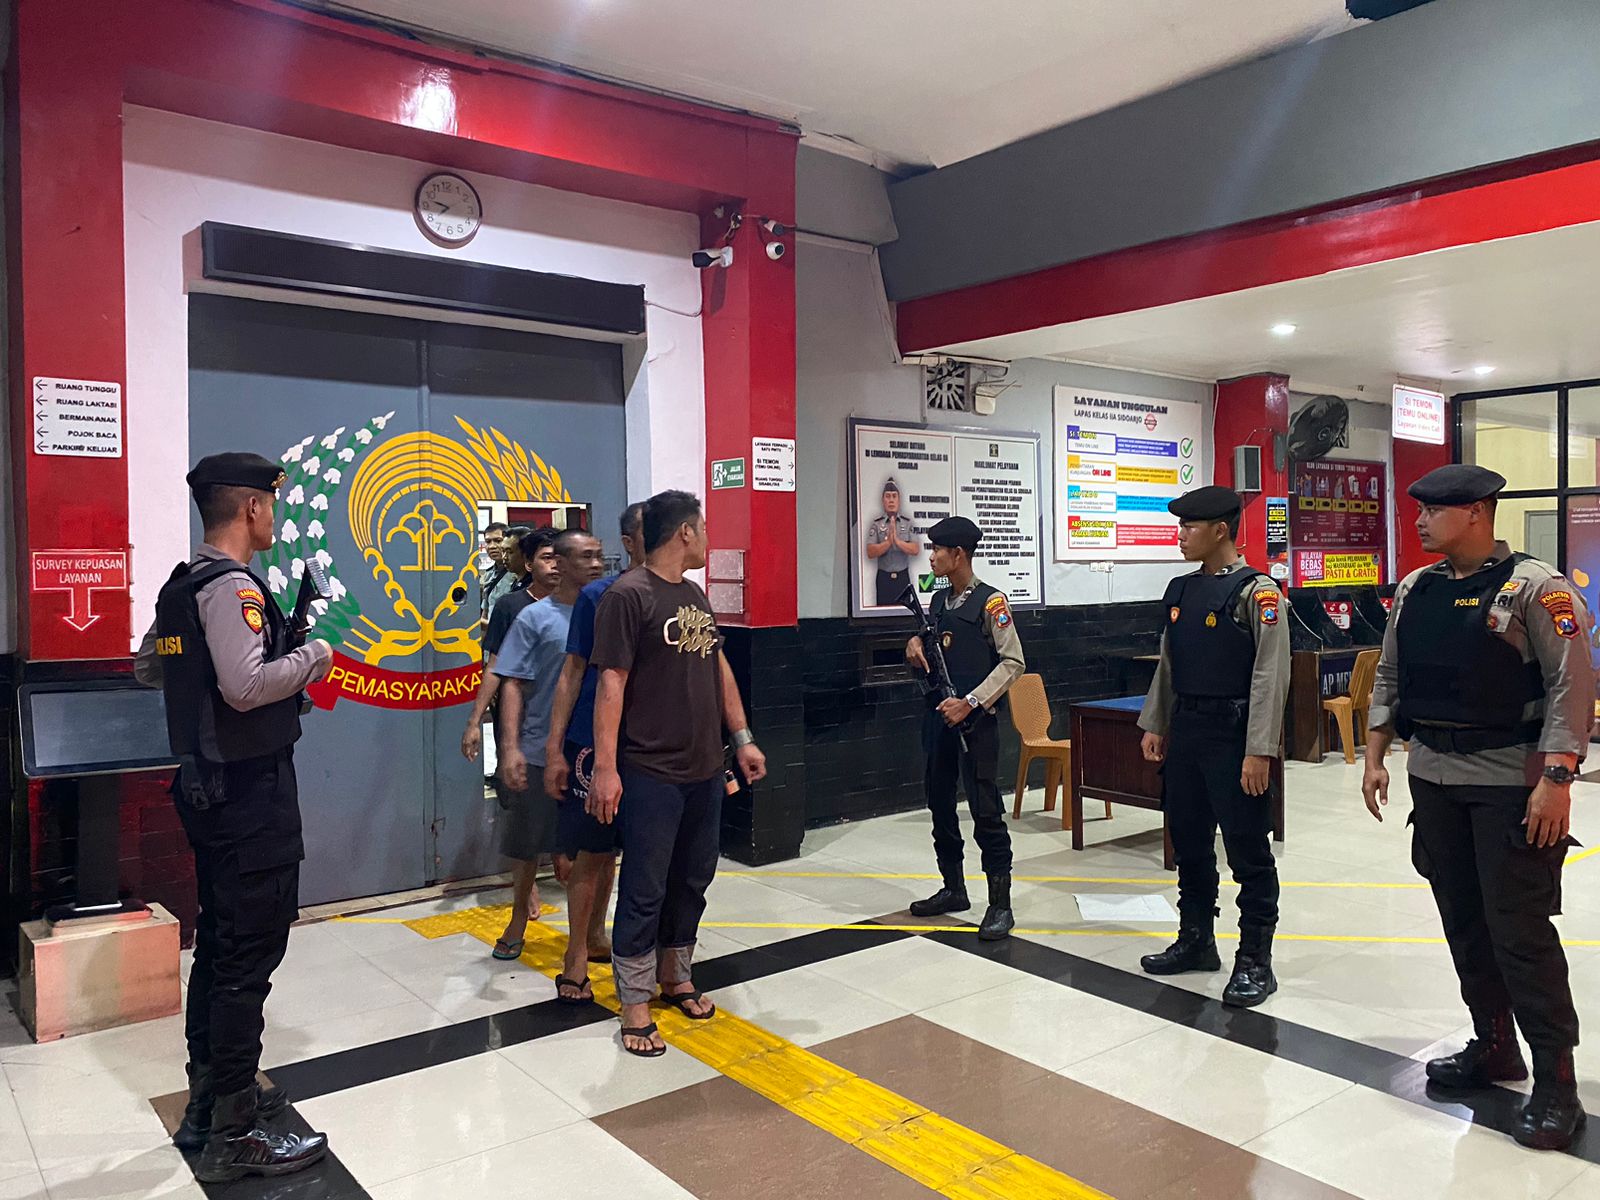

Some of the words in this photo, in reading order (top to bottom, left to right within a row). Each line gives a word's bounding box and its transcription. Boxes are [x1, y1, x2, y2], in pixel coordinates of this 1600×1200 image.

[56, 383, 83, 391] RUANG
[85, 385, 117, 393] TUNGGU
[56, 398, 84, 406] RUANG
[85, 400, 117, 408] LAKTASI
[1073, 396, 1120, 409] LAYANAN
[1121, 402, 1168, 414] UNGGULAN
[1405, 396, 1411, 406] SI
[1412, 398, 1432, 409] TEMON
[59, 413, 93, 421] BERMAIN
[1074, 409, 1092, 418] LAPAS
[1092, 410, 1109, 420] KELAS
[1117, 413, 1142, 424] SIDOARJO
[86, 445, 117, 453] KELUAR
[1300, 552, 1322, 560] WILAYAH
[36, 559, 73, 570] SURVEY
[74, 559, 123, 569] KEPUASAN
[1300, 560, 1322, 570] BEBAS
[59, 573, 102, 583] LAYANAN
[1325, 569, 1344, 579] PASTI
[1346, 570, 1351, 578] &
[1353, 568, 1377, 578] GRATIS
[1454, 598, 1480, 607] POLISI
